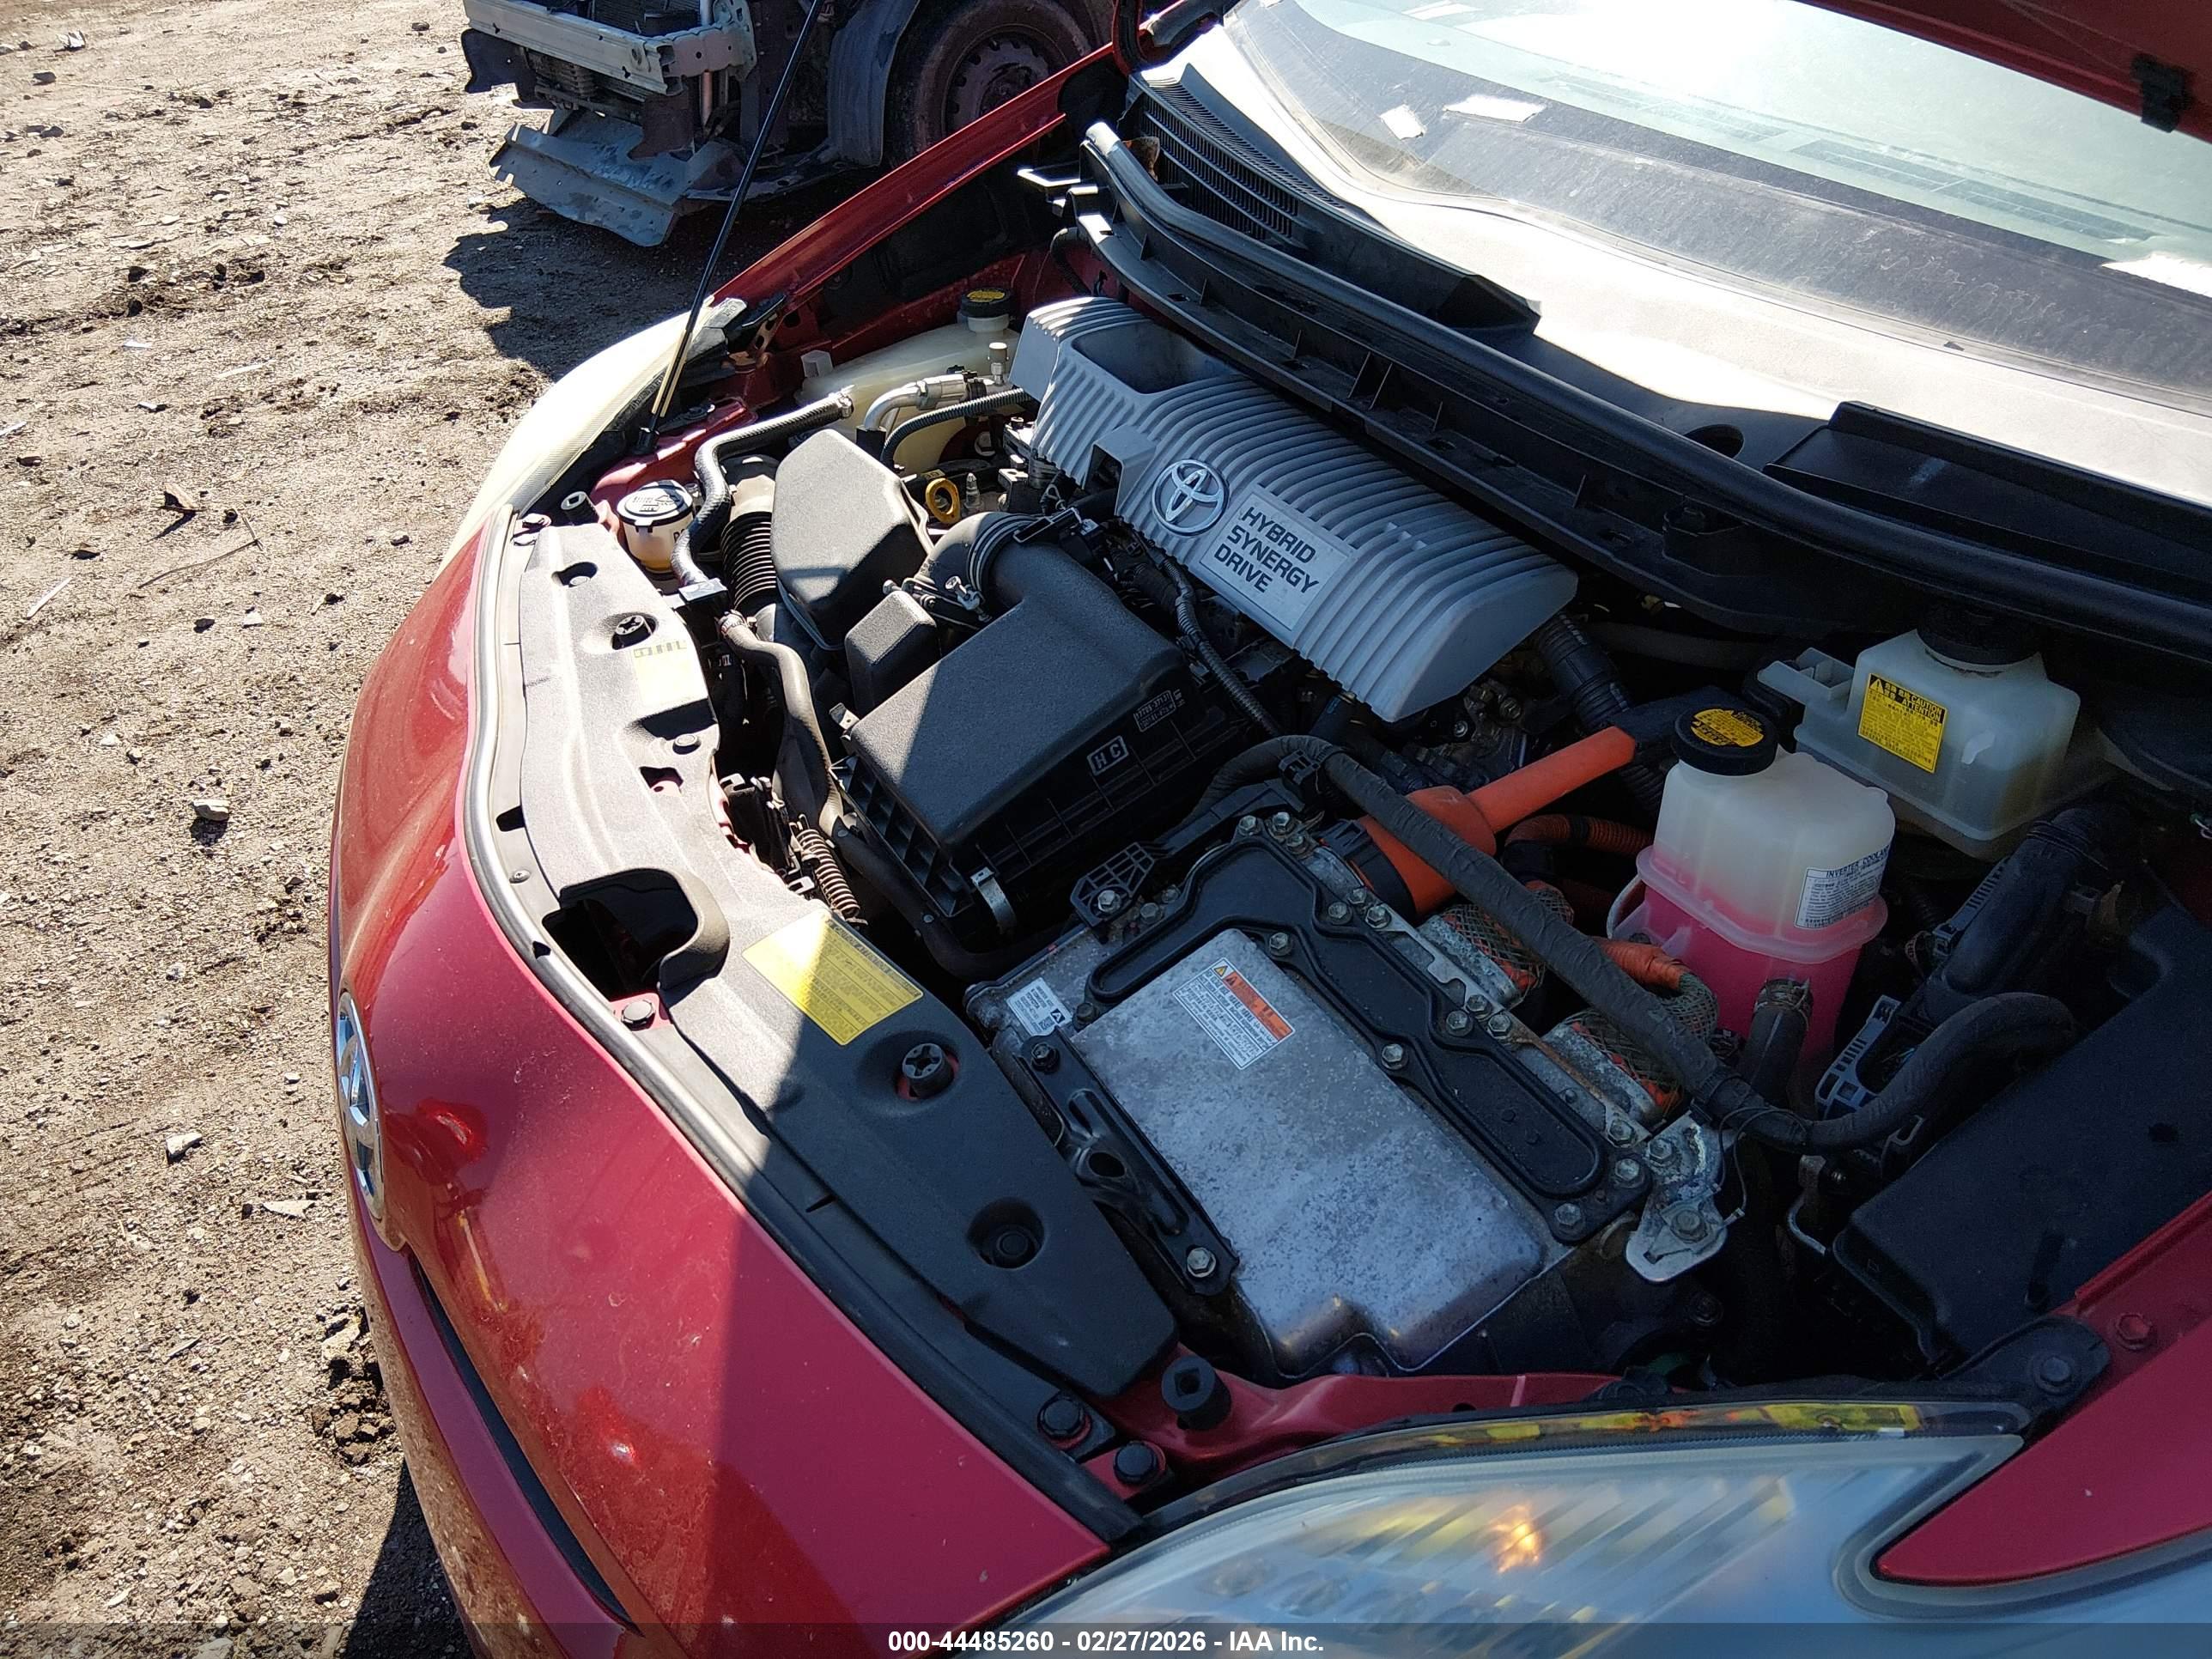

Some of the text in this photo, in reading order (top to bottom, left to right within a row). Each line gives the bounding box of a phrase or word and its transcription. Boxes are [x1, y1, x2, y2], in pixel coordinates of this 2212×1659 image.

[1242, 507, 1316, 563] HYBRID
[1213, 543, 1273, 593] DRIVE
[1227, 526, 1320, 594] SYNERGY
[1902, 698, 1941, 722] ATTENTION
[1911, 695, 1942, 715] CAUTION
[1826, 861, 1859, 878] INVERTER
